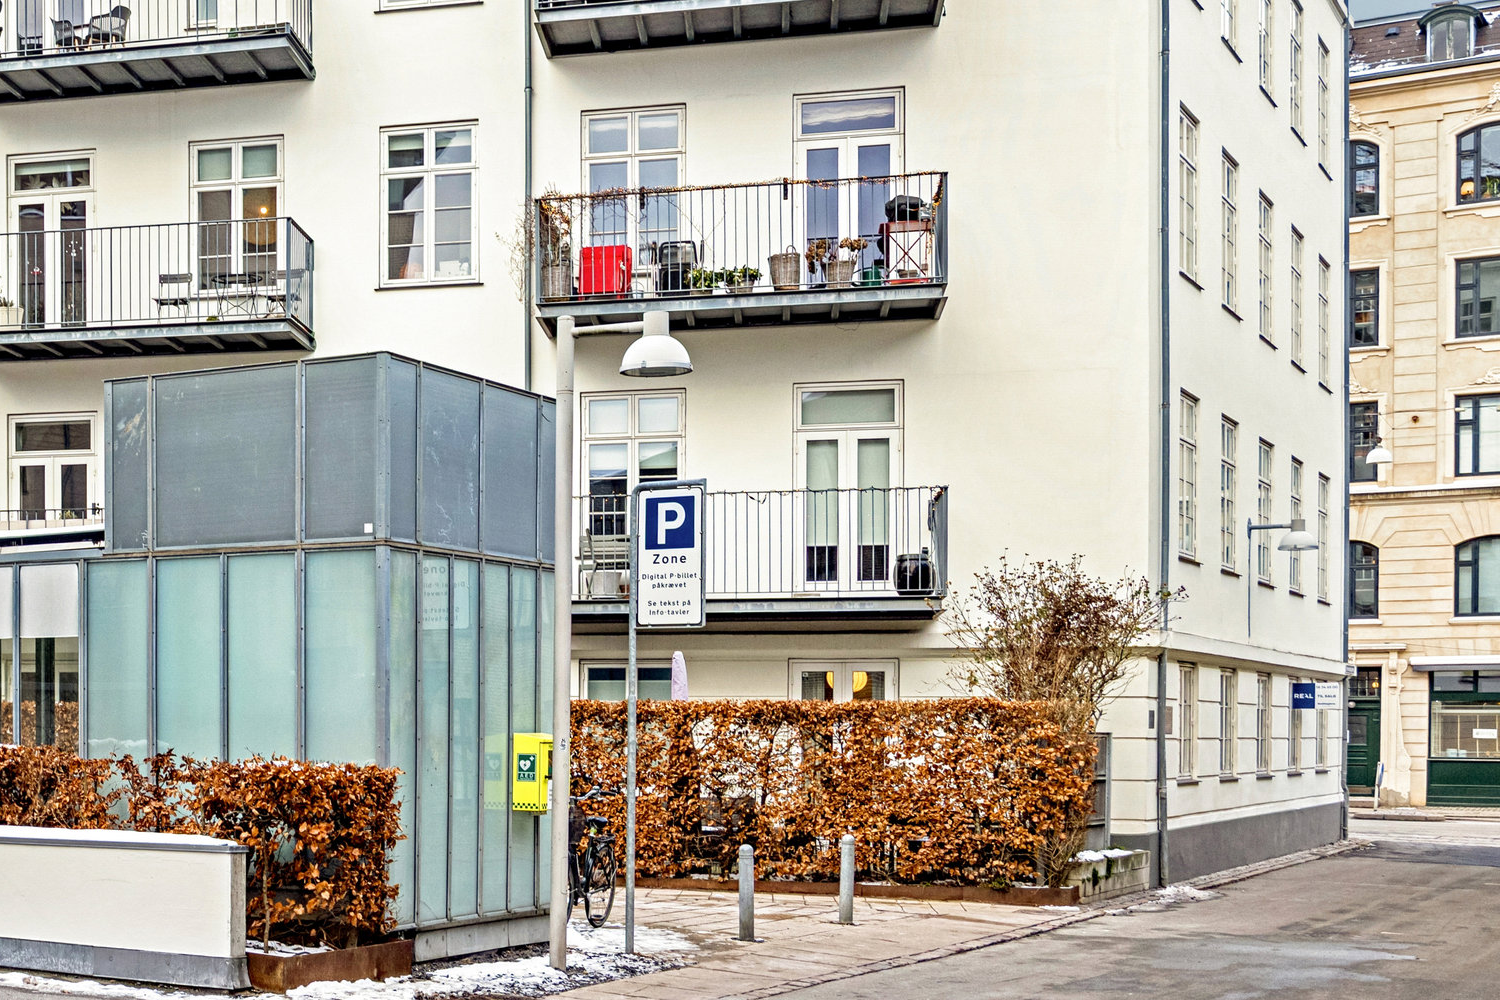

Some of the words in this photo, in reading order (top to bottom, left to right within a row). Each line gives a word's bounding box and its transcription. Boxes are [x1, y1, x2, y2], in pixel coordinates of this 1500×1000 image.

[657, 501, 686, 545] P
[652, 553, 687, 565] Zone
[641, 573, 667, 581] Digital
[652, 581, 687, 589] påkrævet
[682, 599, 691, 608] på
